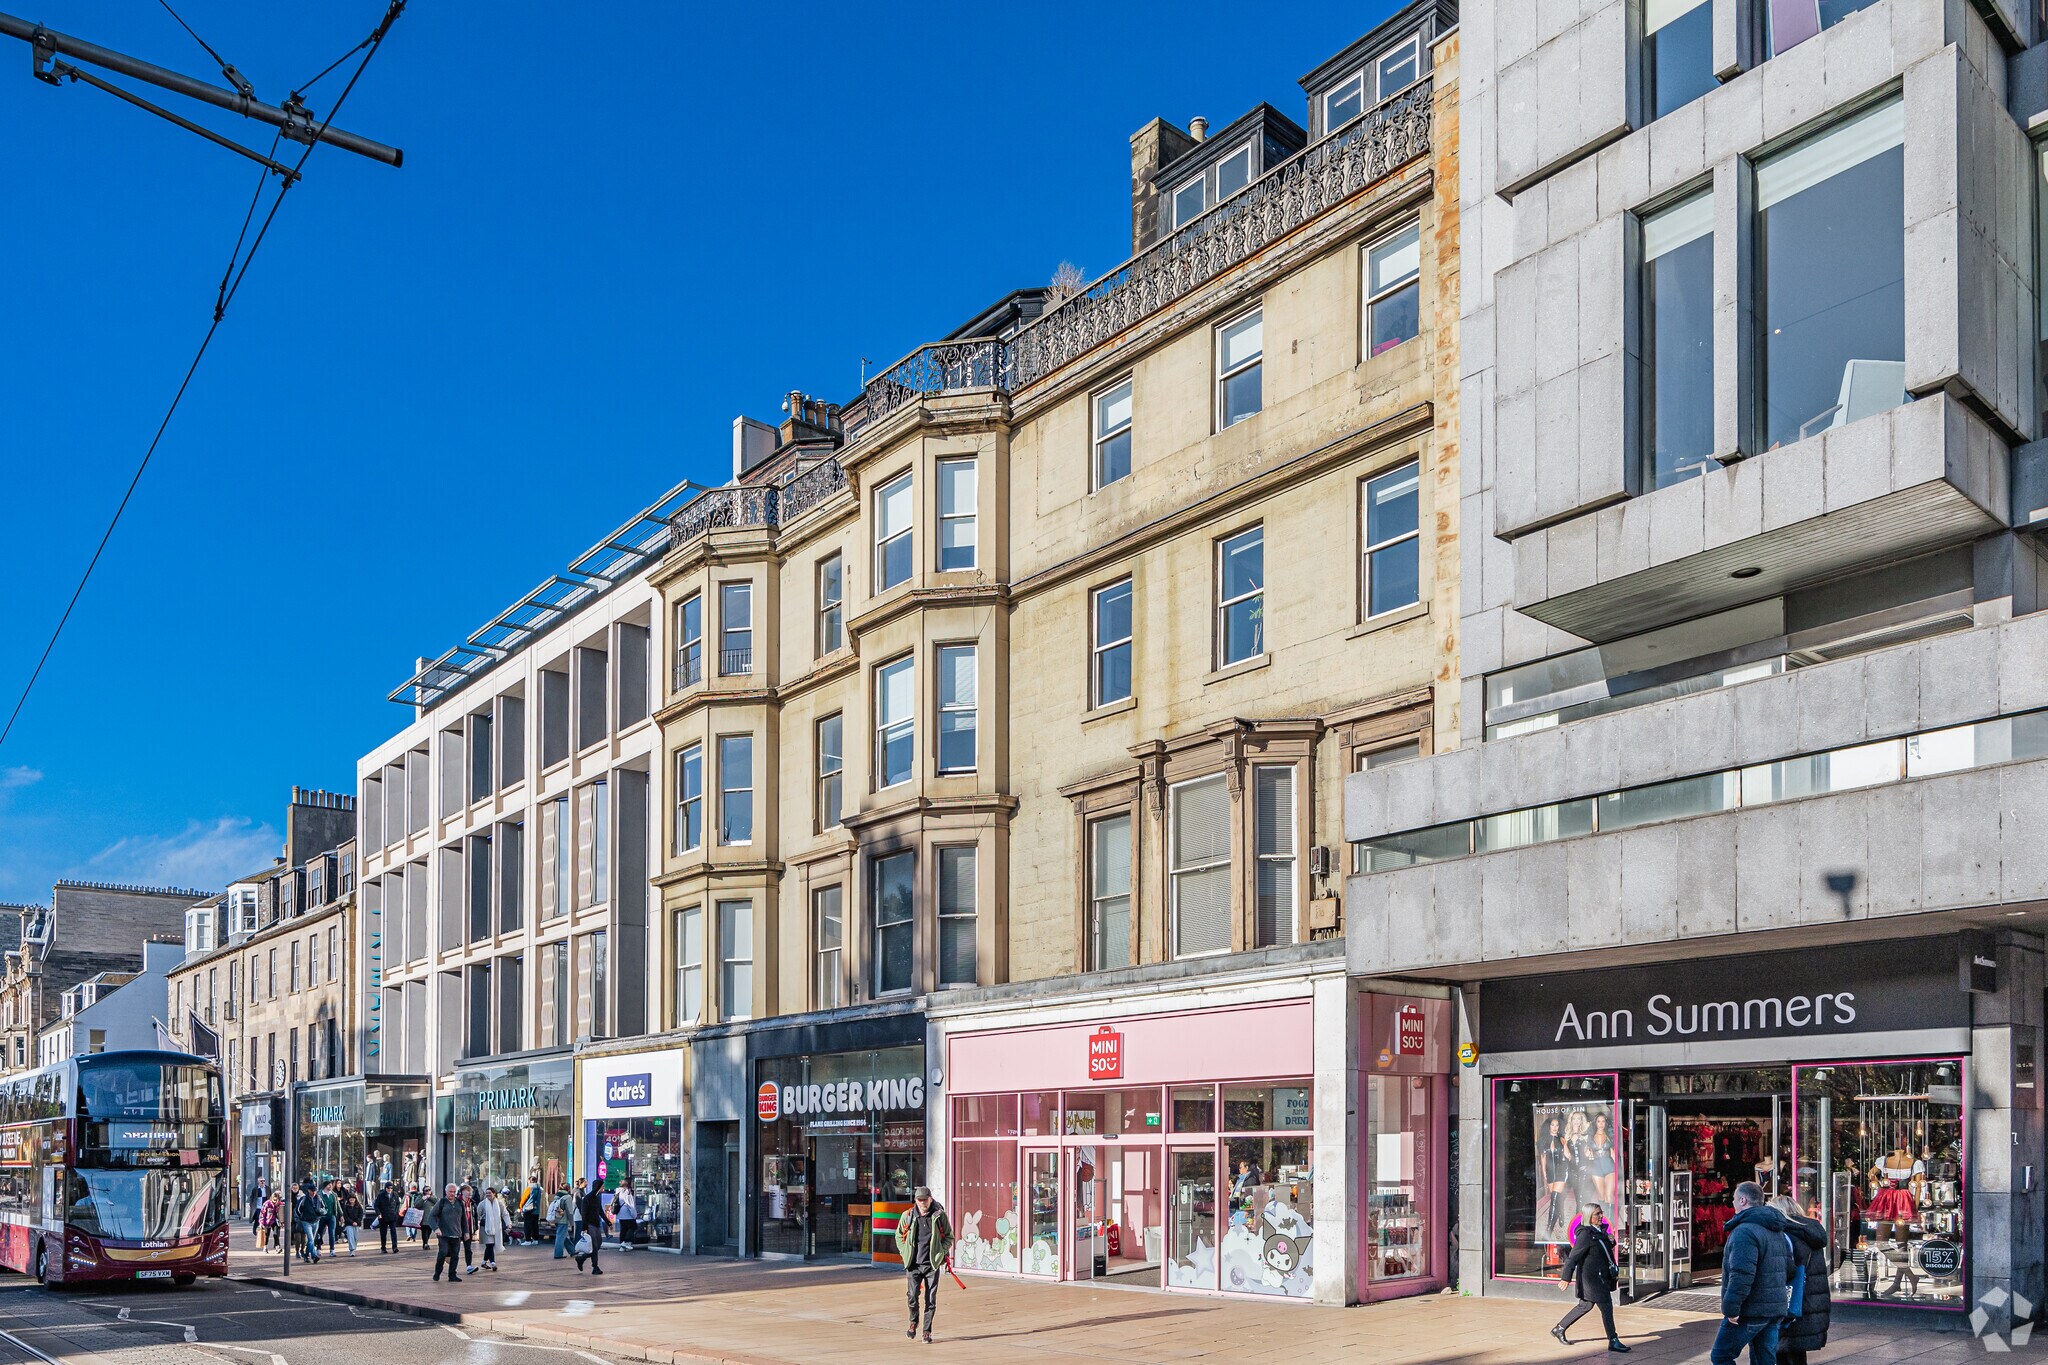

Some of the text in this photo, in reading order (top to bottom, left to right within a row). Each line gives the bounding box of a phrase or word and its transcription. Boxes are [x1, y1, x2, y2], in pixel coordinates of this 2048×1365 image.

[1554, 991, 1856, 1042] Ann Summers
[1403, 1019, 1422, 1032] MINI
[1092, 1040, 1117, 1054] MINI
[480, 1086, 538, 1110] PRIMARK
[609, 1080, 646, 1102] claire's
[783, 1077, 924, 1114] BURGER KING
[759, 1101, 777, 1112] KING
[1287, 1099, 1308, 1108] FOOD
[310, 1106, 345, 1122] PRIMARK
[491, 1113, 528, 1129] Edinburgh
[1285, 1116, 1308, 1125] DRIN
[318, 1125, 341, 1137] Edinburgh
[1924, 1251, 1953, 1263] 15%
